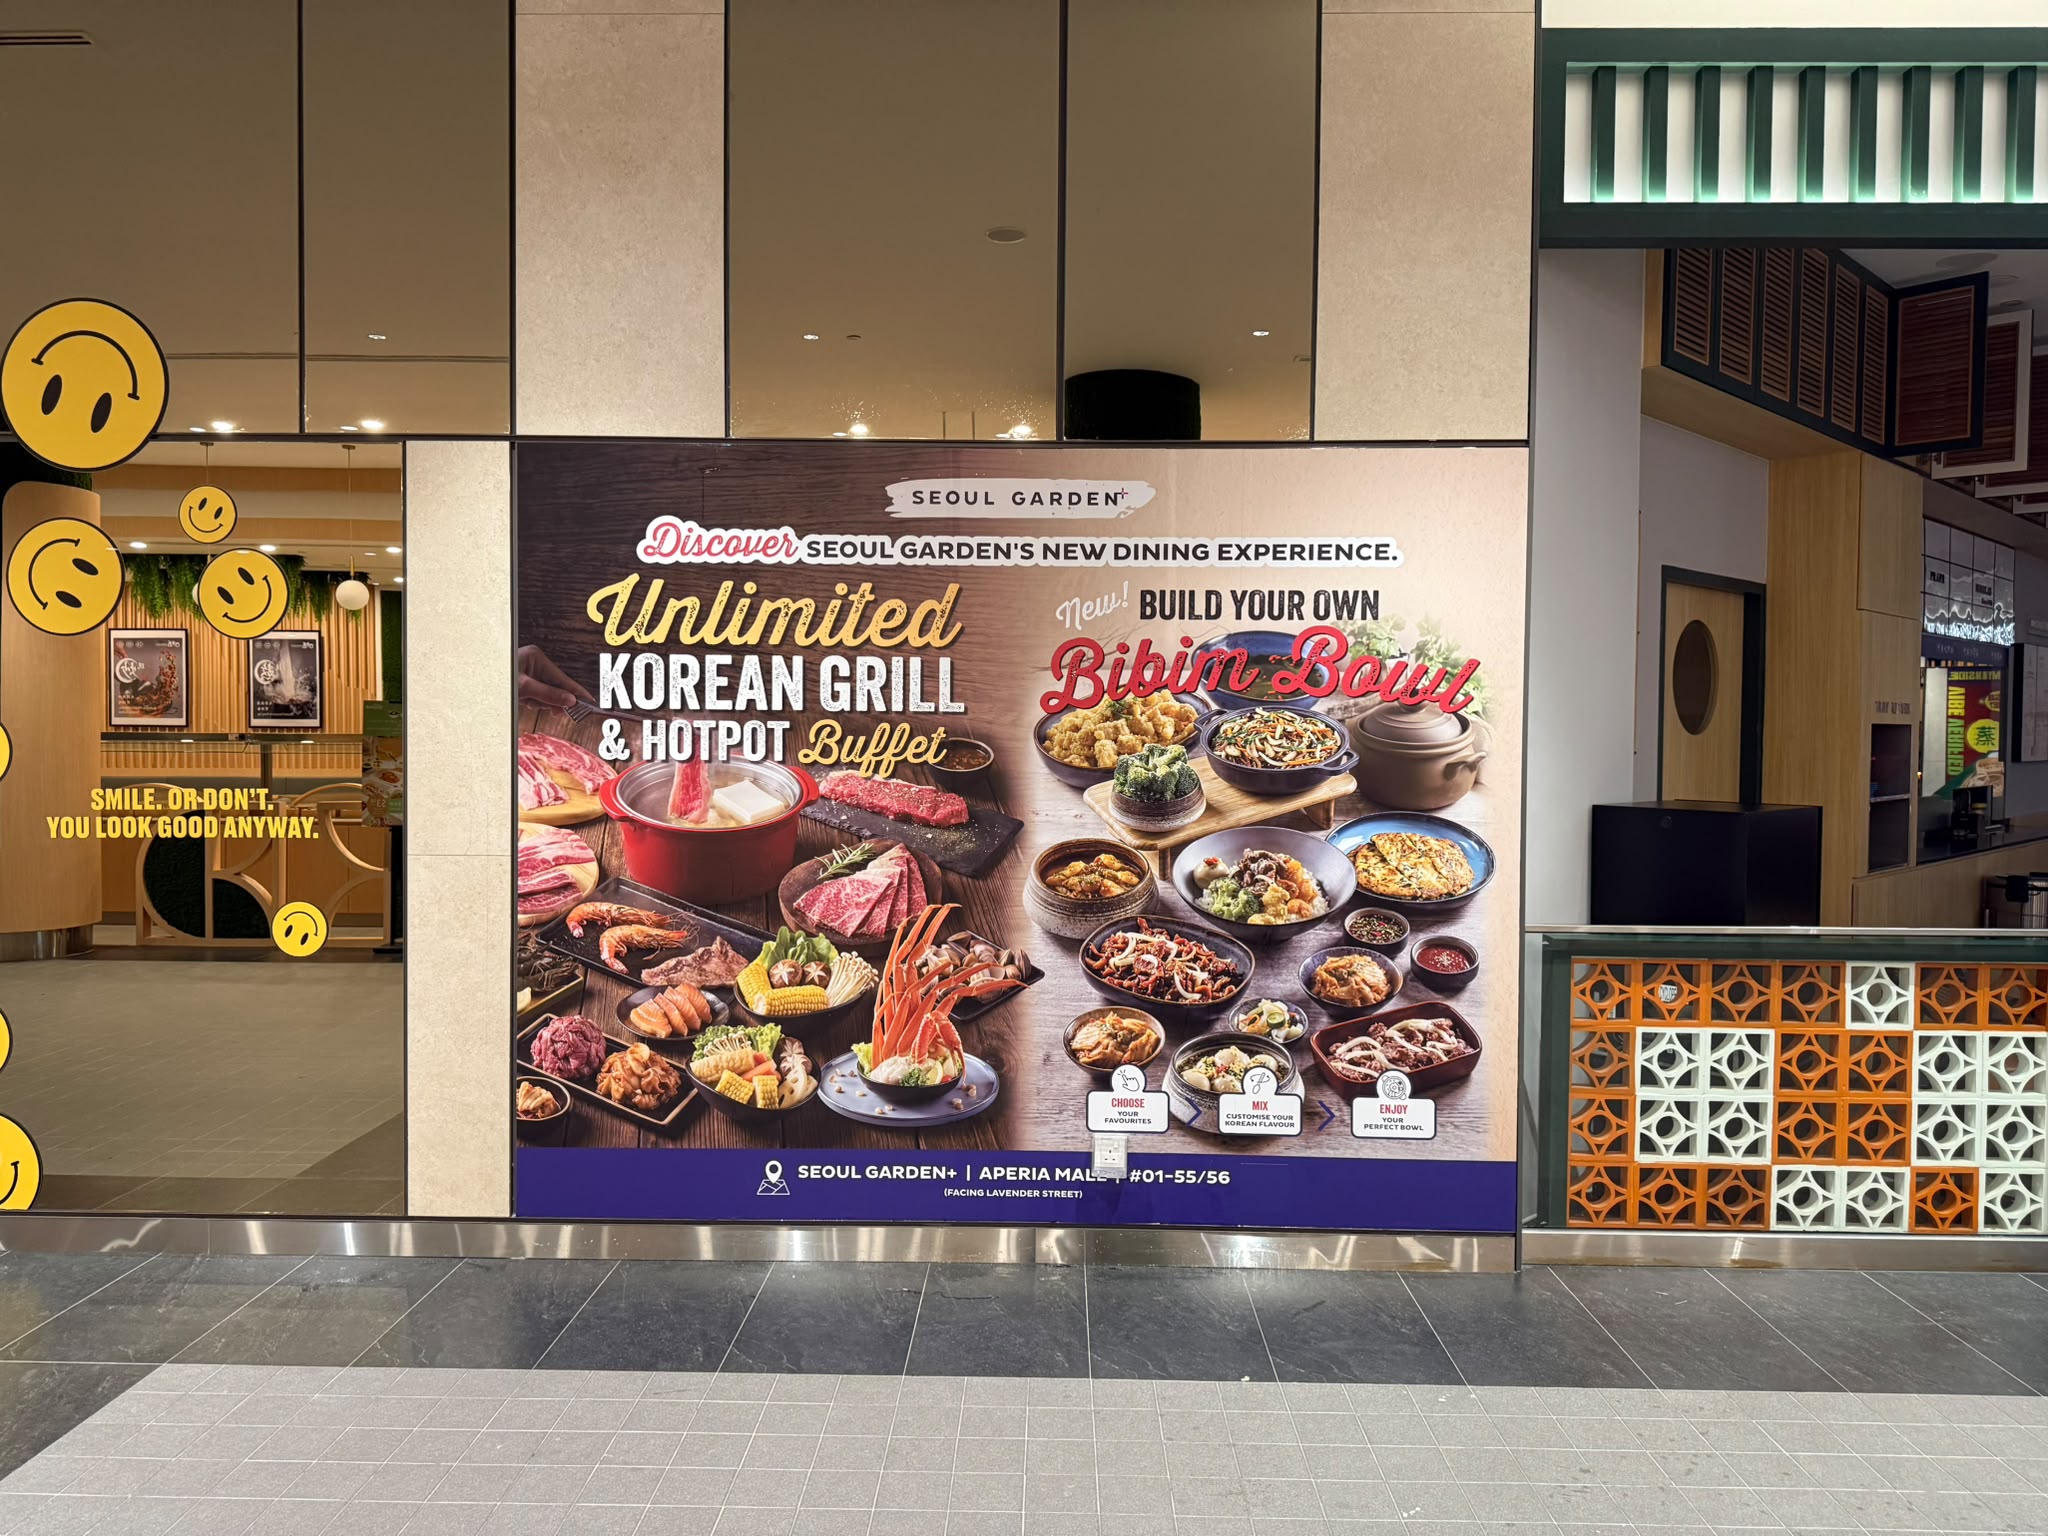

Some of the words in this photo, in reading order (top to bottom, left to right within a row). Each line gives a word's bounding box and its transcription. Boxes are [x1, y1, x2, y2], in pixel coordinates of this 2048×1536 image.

[912, 491, 994, 505] SEOUL
[643, 522, 798, 558] Discover
[807, 541, 893, 558] SEOUL
[901, 541, 1034, 560] GARDEN'S
[1043, 543, 1107, 560] NEW
[1113, 543, 1209, 561] DINING
[1217, 543, 1398, 561] EXPERIENCE.
[587, 572, 963, 648] Unlimited
[1055, 580, 1129, 631] New!
[1140, 589, 1222, 621] BUILD
[1230, 589, 1305, 621] YOUR
[1313, 589, 1380, 621] OWN
[1040, 635, 1262, 714] Bibim
[1271, 625, 1482, 714] Bowl
[599, 652, 804, 712] KOREAN
[820, 655, 965, 713] GRILL
[598, 718, 630, 761] &
[642, 719, 790, 762] HOTPOT
[798, 718, 947, 778] Buffet
[90, 788, 162, 810] SMILE.
[168, 788, 198, 810] OR
[203, 788, 274, 810] DON'T.
[46, 816, 90, 838] YOU
[96, 816, 152, 838] LOOK
[158, 816, 218, 838] GOOD
[223, 816, 319, 838] ANYWAY.
[1111, 1098, 1145, 1108] CHOOSE
[1252, 1101, 1269, 1111] MIX
[1379, 1104, 1409, 1114] ENJOY
[798, 1165, 862, 1179] SEOUL
[865, 1165, 958, 1179] GARDEN+
[979, 1166, 1051, 1181] APERIA
[1129, 1169, 1231, 1185] #01-55/56
[943, 1188, 985, 1198] (FACING
[986, 1189, 1041, 1198] LAVENDER
[1042, 1190, 1083, 1199] STREET)
